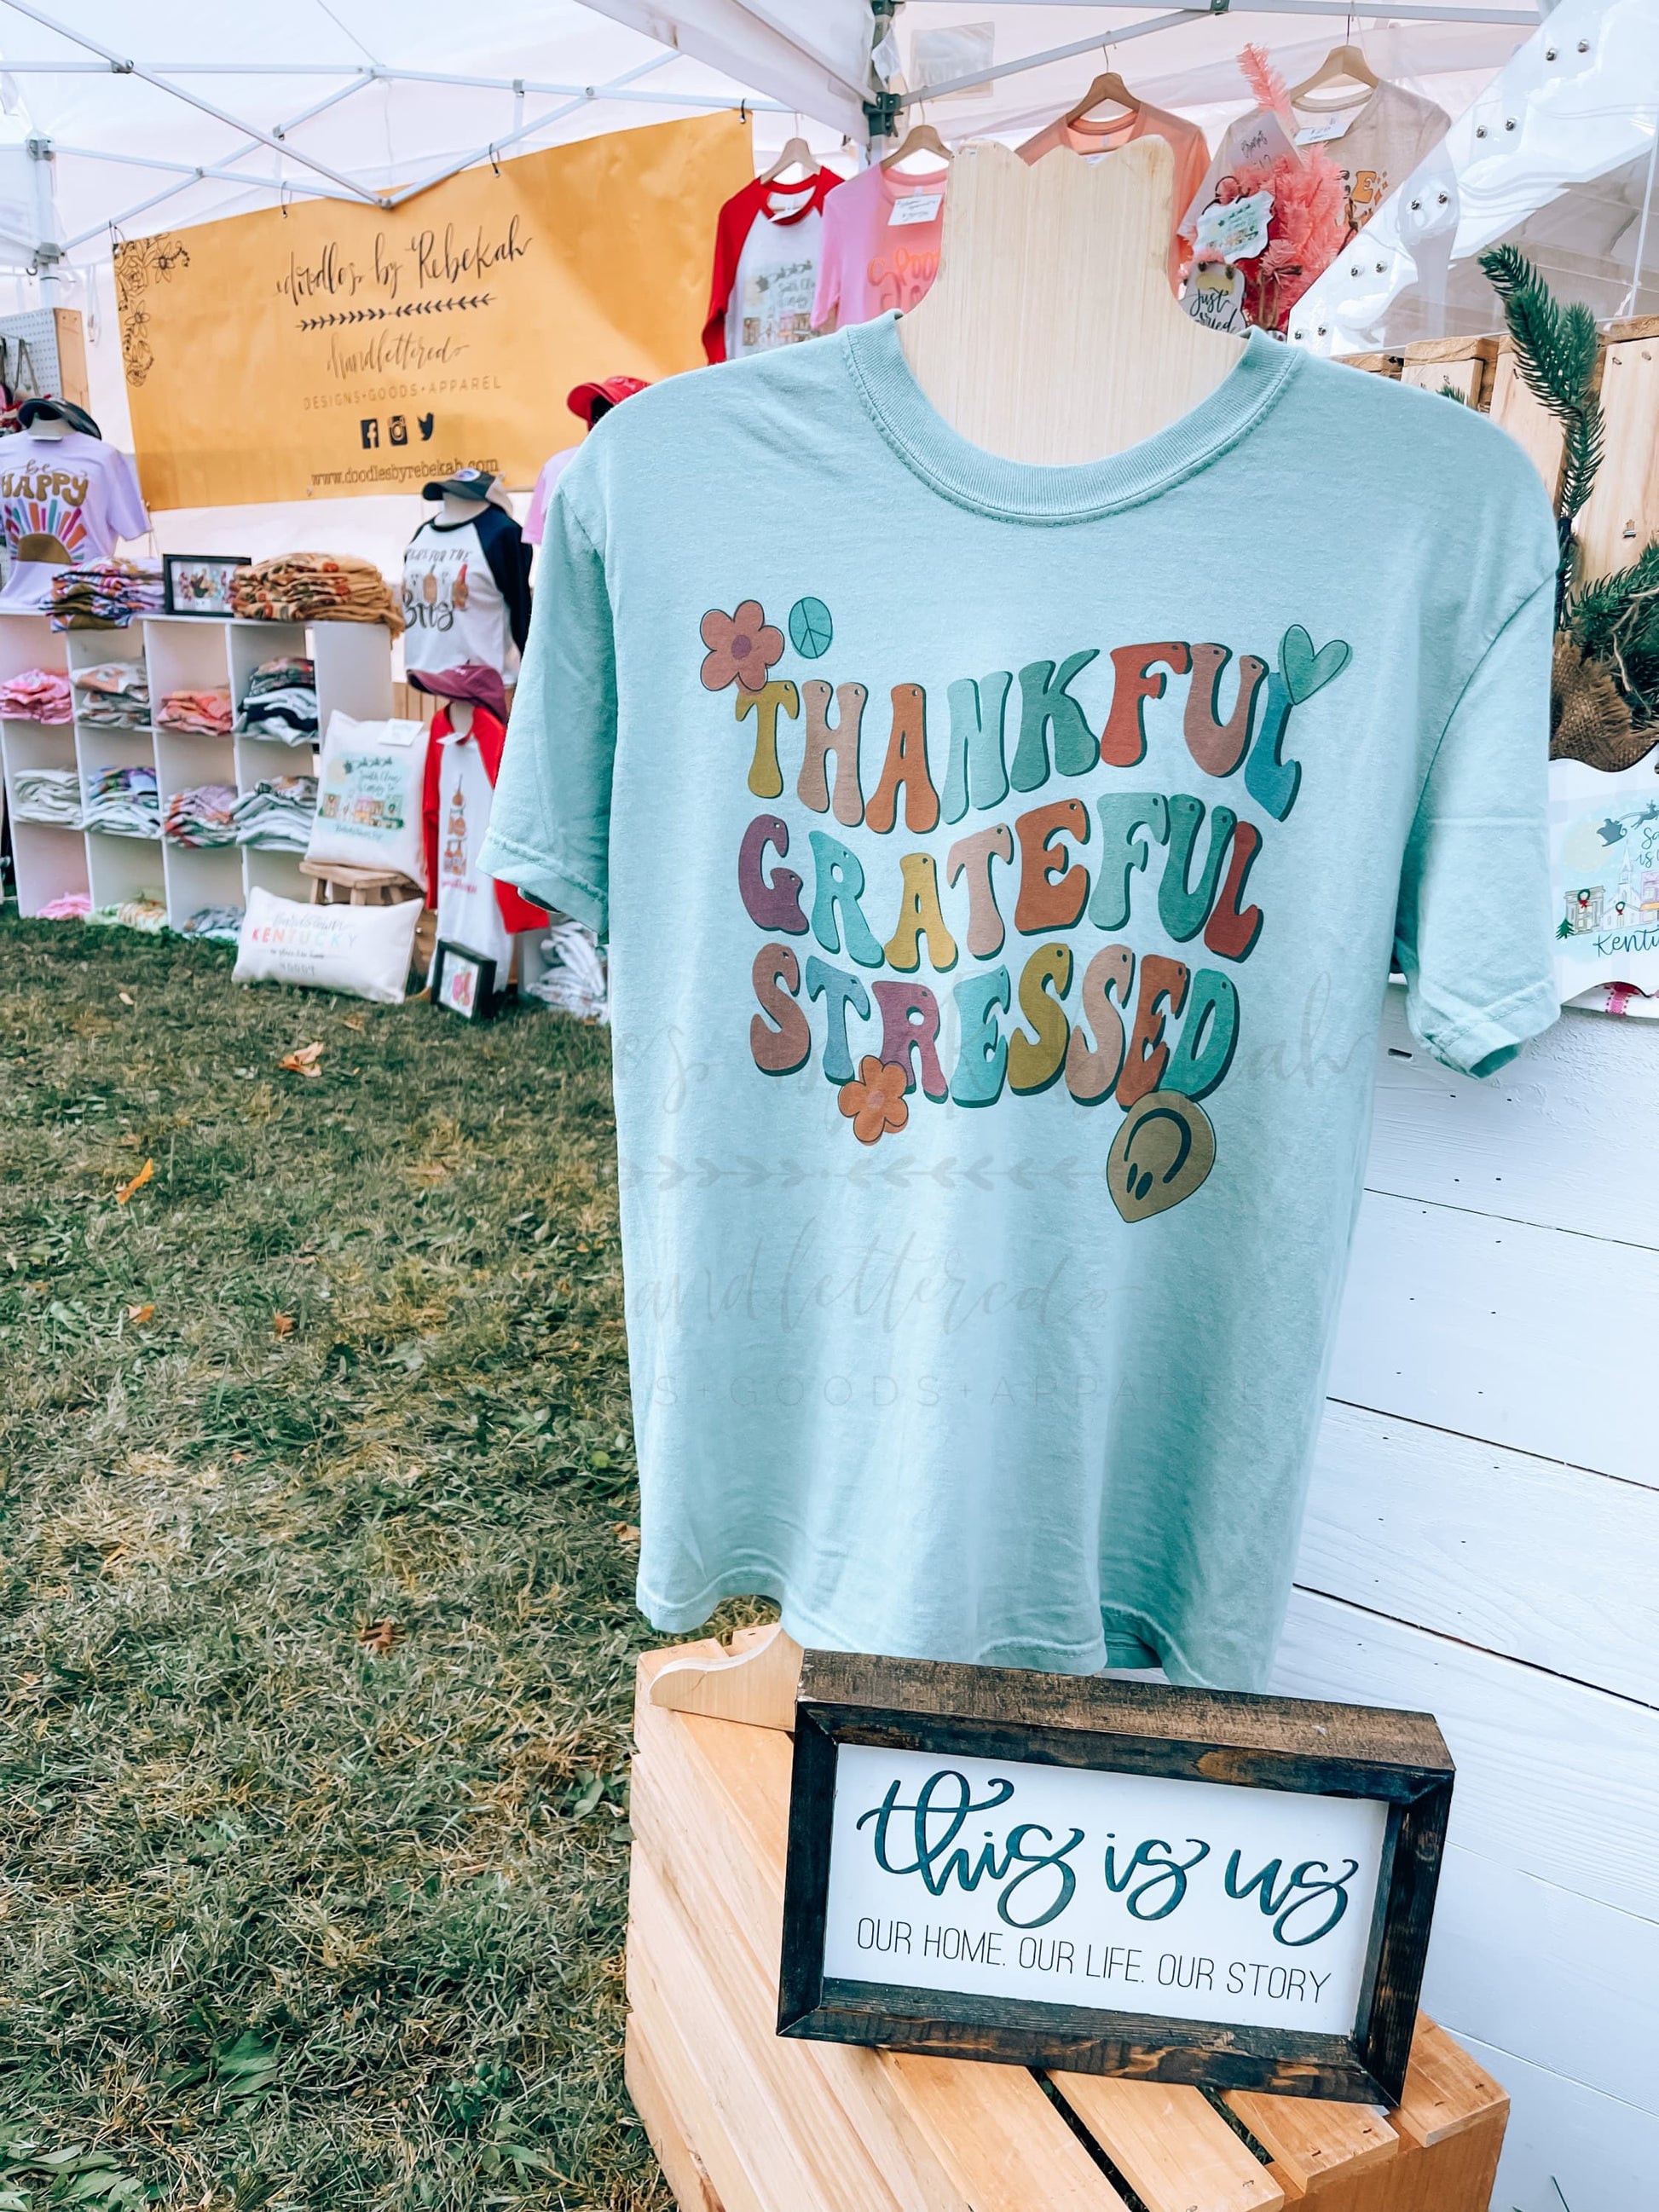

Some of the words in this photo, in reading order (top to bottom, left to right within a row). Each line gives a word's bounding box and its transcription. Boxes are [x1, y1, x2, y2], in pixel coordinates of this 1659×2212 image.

[369, 232, 404, 299] by
[405, 214, 533, 289] Rebekah
[2, 472, 89, 507] HAPPY
[311, 458, 499, 486] www.doodlesbyrebekahcom
[736, 641, 1302, 834] THANKFUL
[738, 792, 1263, 973] GRATEFUL
[251, 926, 358, 949] KENTUCKY
[750, 941, 1240, 1112] STRESSED
[856, 1770, 1084, 1929] this
[1104, 1833, 1211, 1921] is
[1224, 1849, 1360, 1948] us
[856, 1917, 912, 1953] OUR
[923, 1925, 1008, 1967] HOME.
[1019, 1936, 1075, 1975] OUR
[1085, 1943, 1146, 1984] LIFE.
[1157, 1953, 1215, 1992] OUR
[1226, 1962, 1332, 2005] STORY
